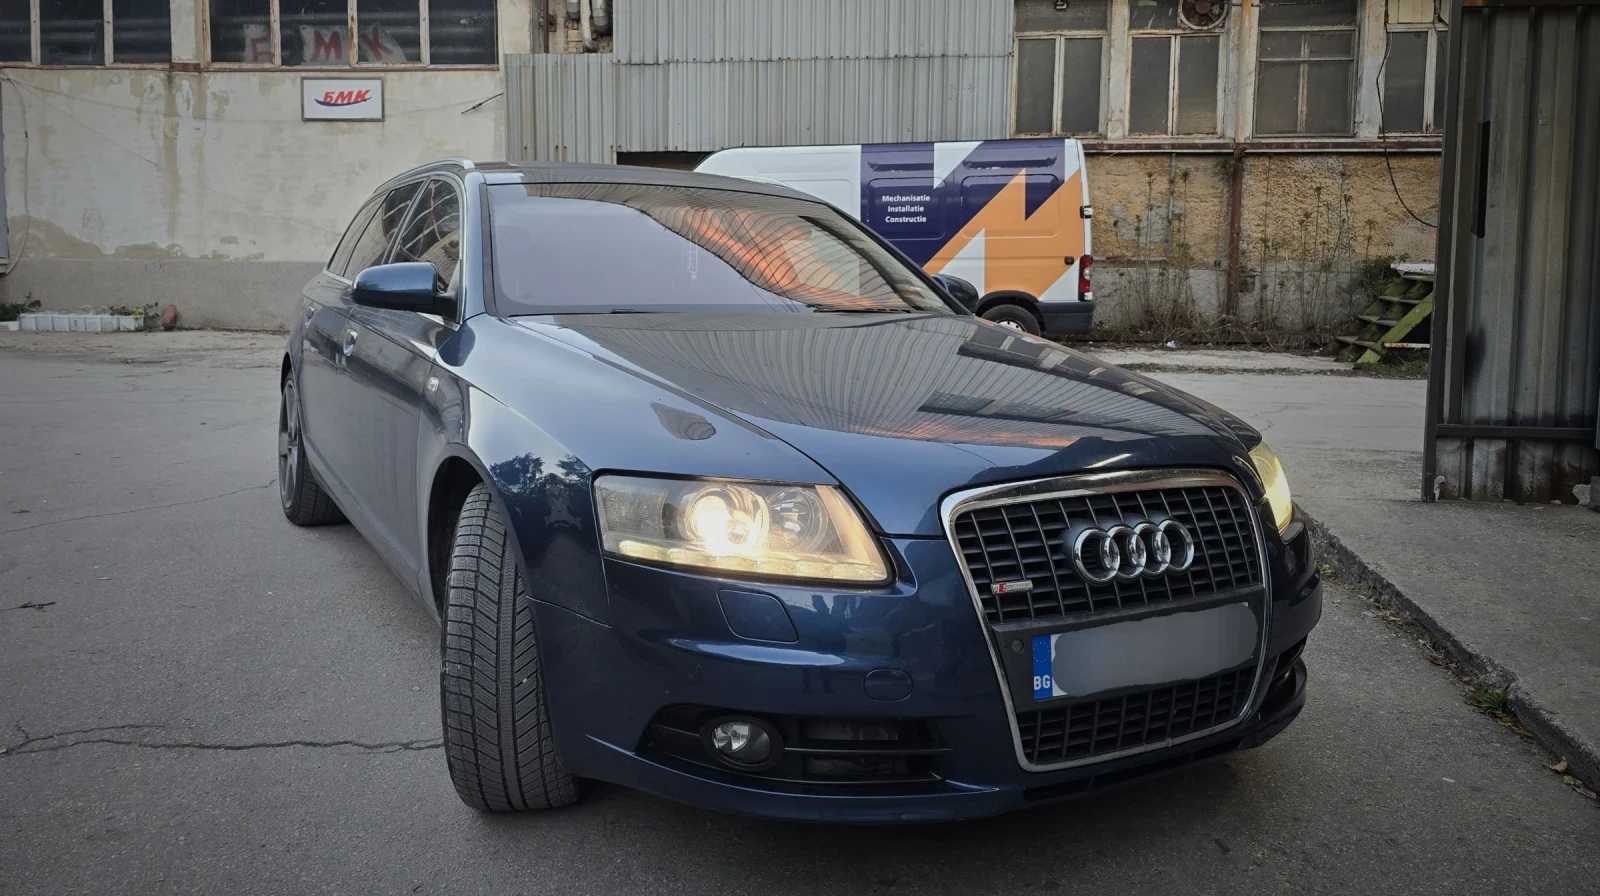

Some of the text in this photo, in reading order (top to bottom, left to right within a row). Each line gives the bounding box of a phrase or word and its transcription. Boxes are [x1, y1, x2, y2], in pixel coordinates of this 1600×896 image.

[323, 89, 371, 104] БМК
[885, 215, 927, 223] Constructie
[1033, 674, 1051, 691] BG
